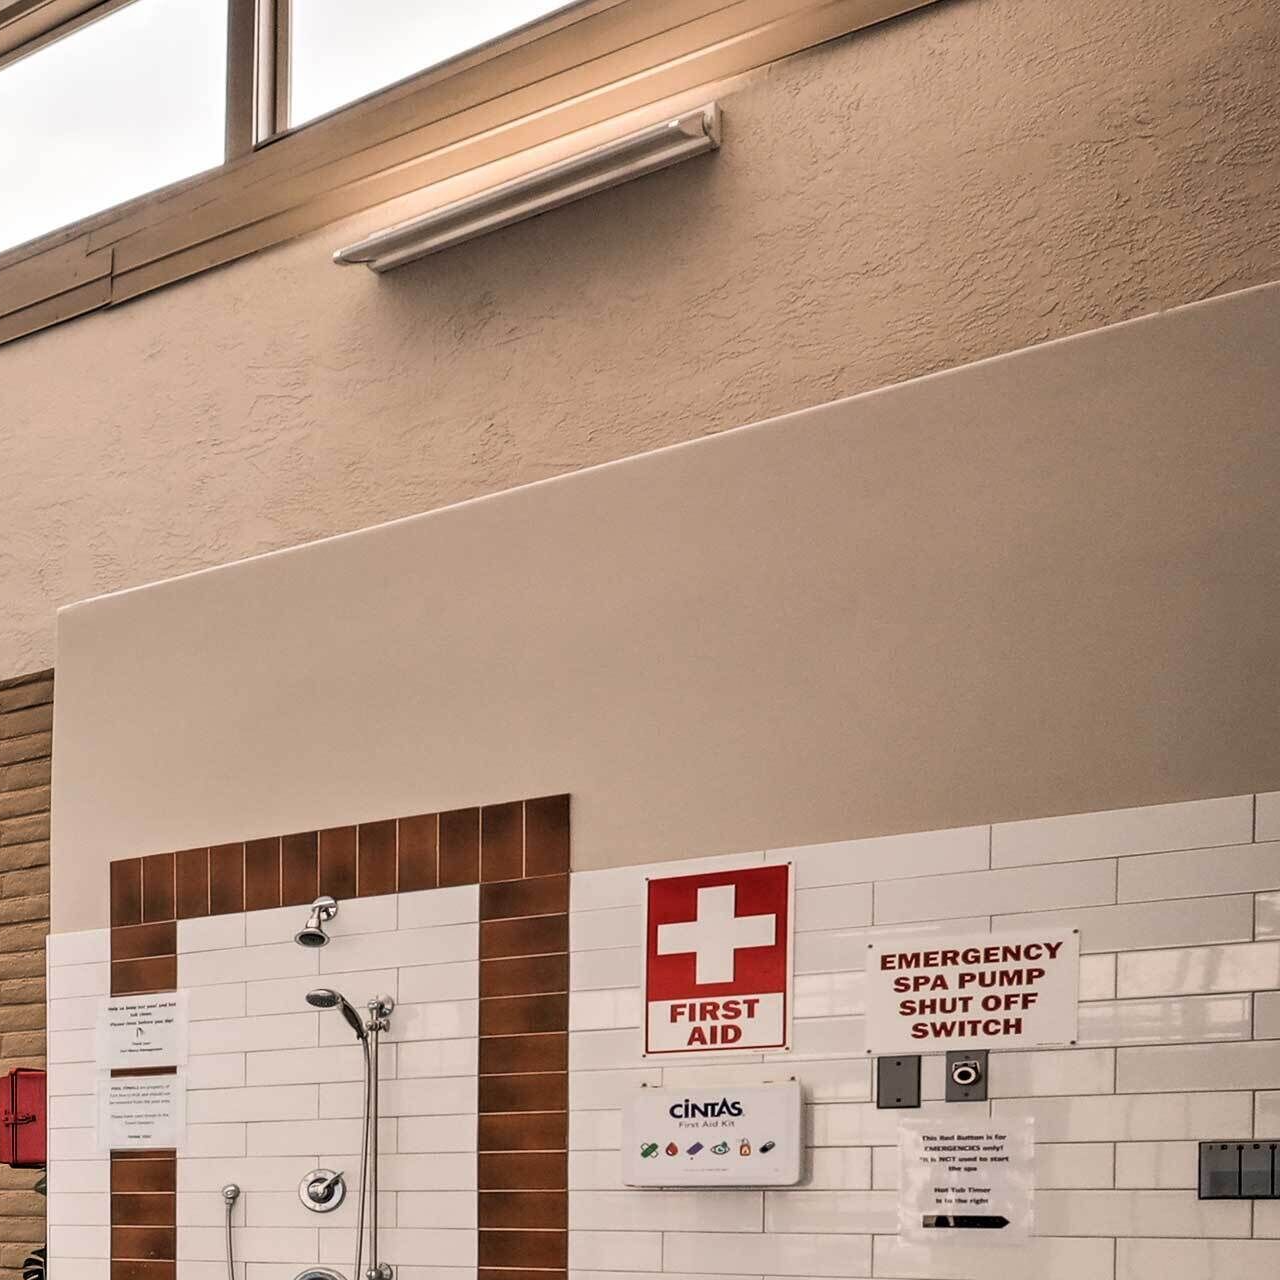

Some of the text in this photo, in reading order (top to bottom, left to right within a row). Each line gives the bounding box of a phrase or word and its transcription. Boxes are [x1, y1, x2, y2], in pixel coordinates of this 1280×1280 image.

[880, 941, 1064, 971] EMERGENCY
[893, 968, 1046, 993] SPA PUMP
[670, 998, 760, 1023] FIRST
[899, 992, 1038, 1016] SHUT OFF
[687, 1024, 742, 1046] AID
[911, 1018, 1023, 1039] SWITCH
[678, 1121, 699, 1129] First
[702, 1120, 719, 1128] Aid
